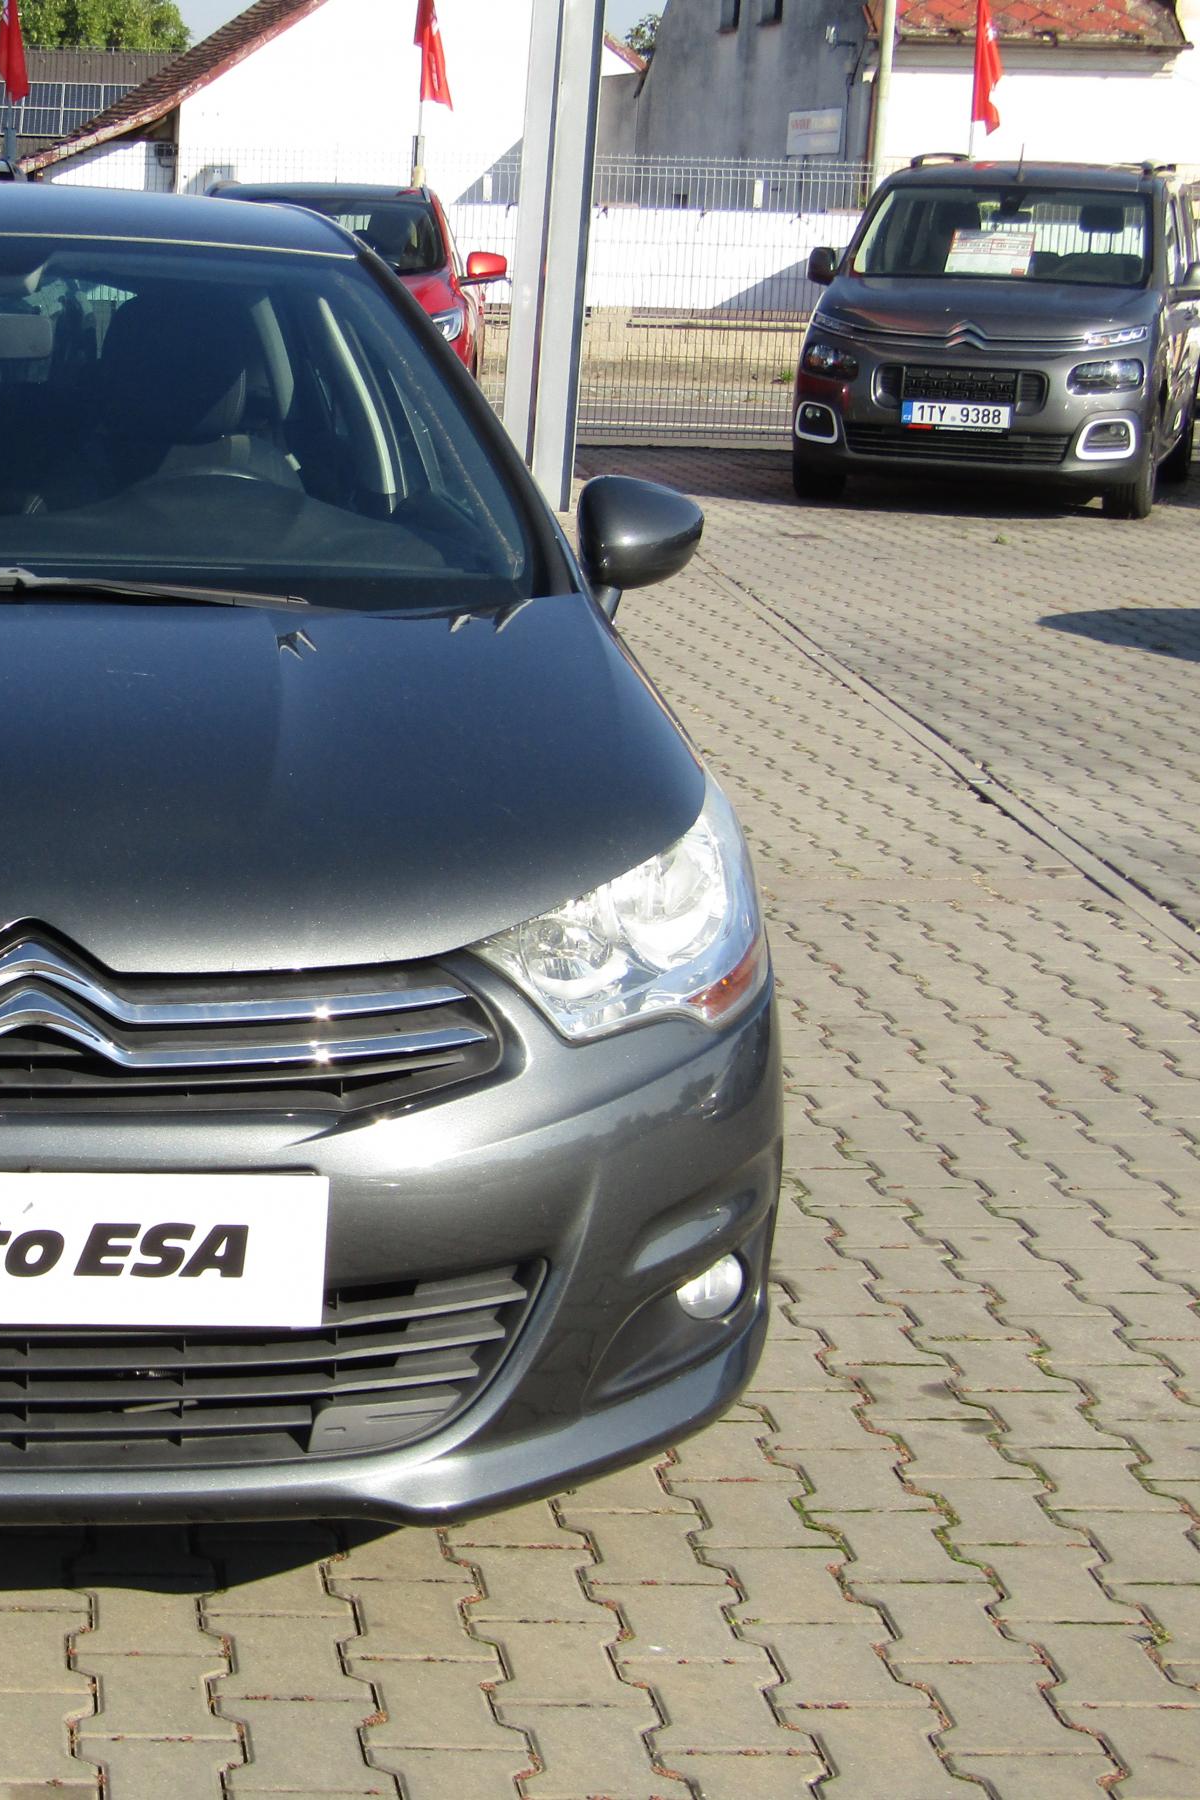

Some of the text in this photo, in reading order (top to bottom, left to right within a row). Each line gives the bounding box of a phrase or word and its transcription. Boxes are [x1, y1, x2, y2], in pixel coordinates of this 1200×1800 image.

[917, 404, 1001, 425] 1TY 9388
[73, 1222, 249, 1278] ESA
